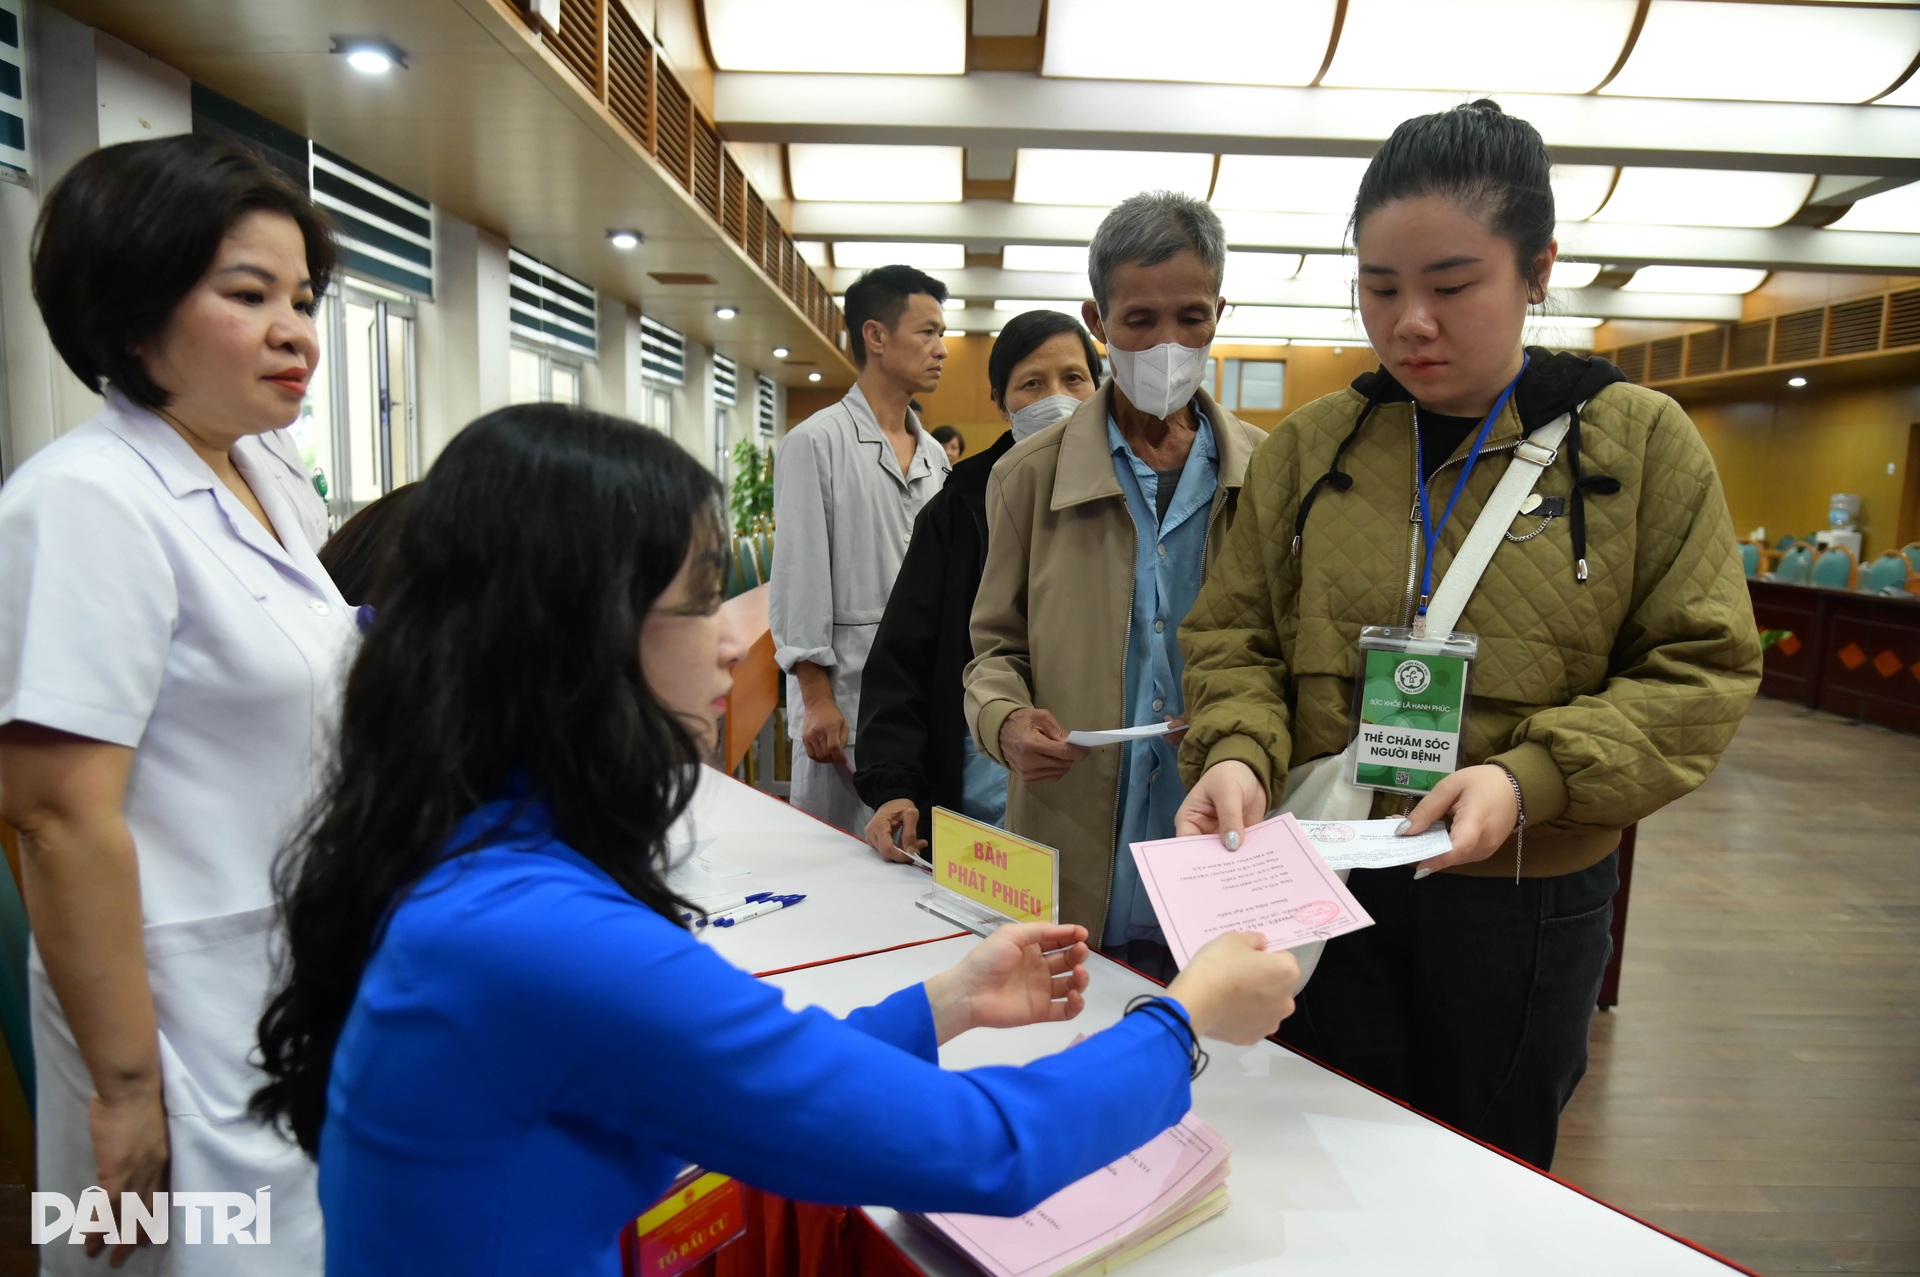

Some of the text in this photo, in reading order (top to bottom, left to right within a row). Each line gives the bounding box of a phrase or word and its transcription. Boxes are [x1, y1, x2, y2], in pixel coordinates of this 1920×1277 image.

[1412, 703, 1430, 711] HẠNH
[1364, 731, 1450, 750] THẺ CHĂM SÓC
[1371, 747, 1441, 763] NGƯỜI BỆNH
[974, 840, 1008, 870] BÀN
[948, 860, 1041, 917] PHÁT PHIẾU
